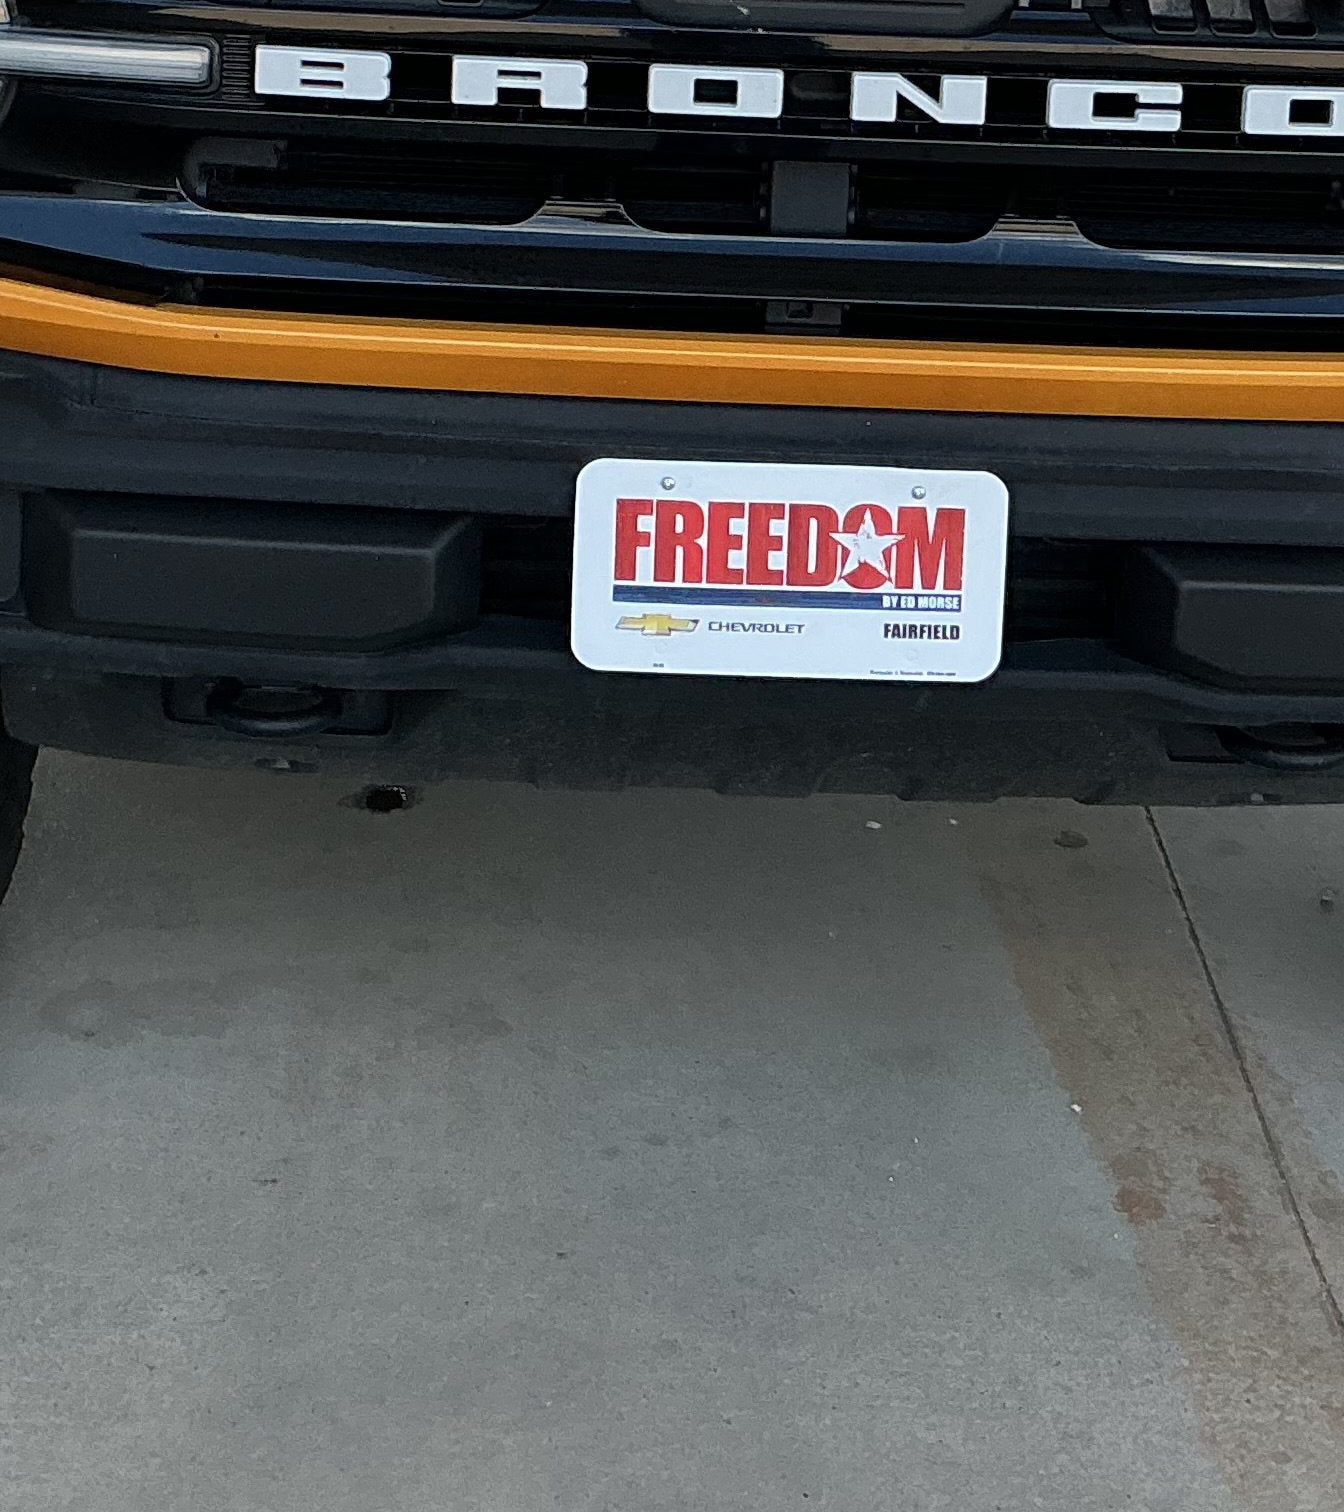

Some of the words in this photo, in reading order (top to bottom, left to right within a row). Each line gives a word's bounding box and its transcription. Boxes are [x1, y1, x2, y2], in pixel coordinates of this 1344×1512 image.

[613, 498, 966, 591] FREEDOM
[882, 595, 899, 609] BY
[900, 595, 917, 609] ED
[917, 596, 960, 610] MORSE
[707, 620, 806, 635] CHEVROLET
[883, 623, 961, 640] FAIRFIELD
